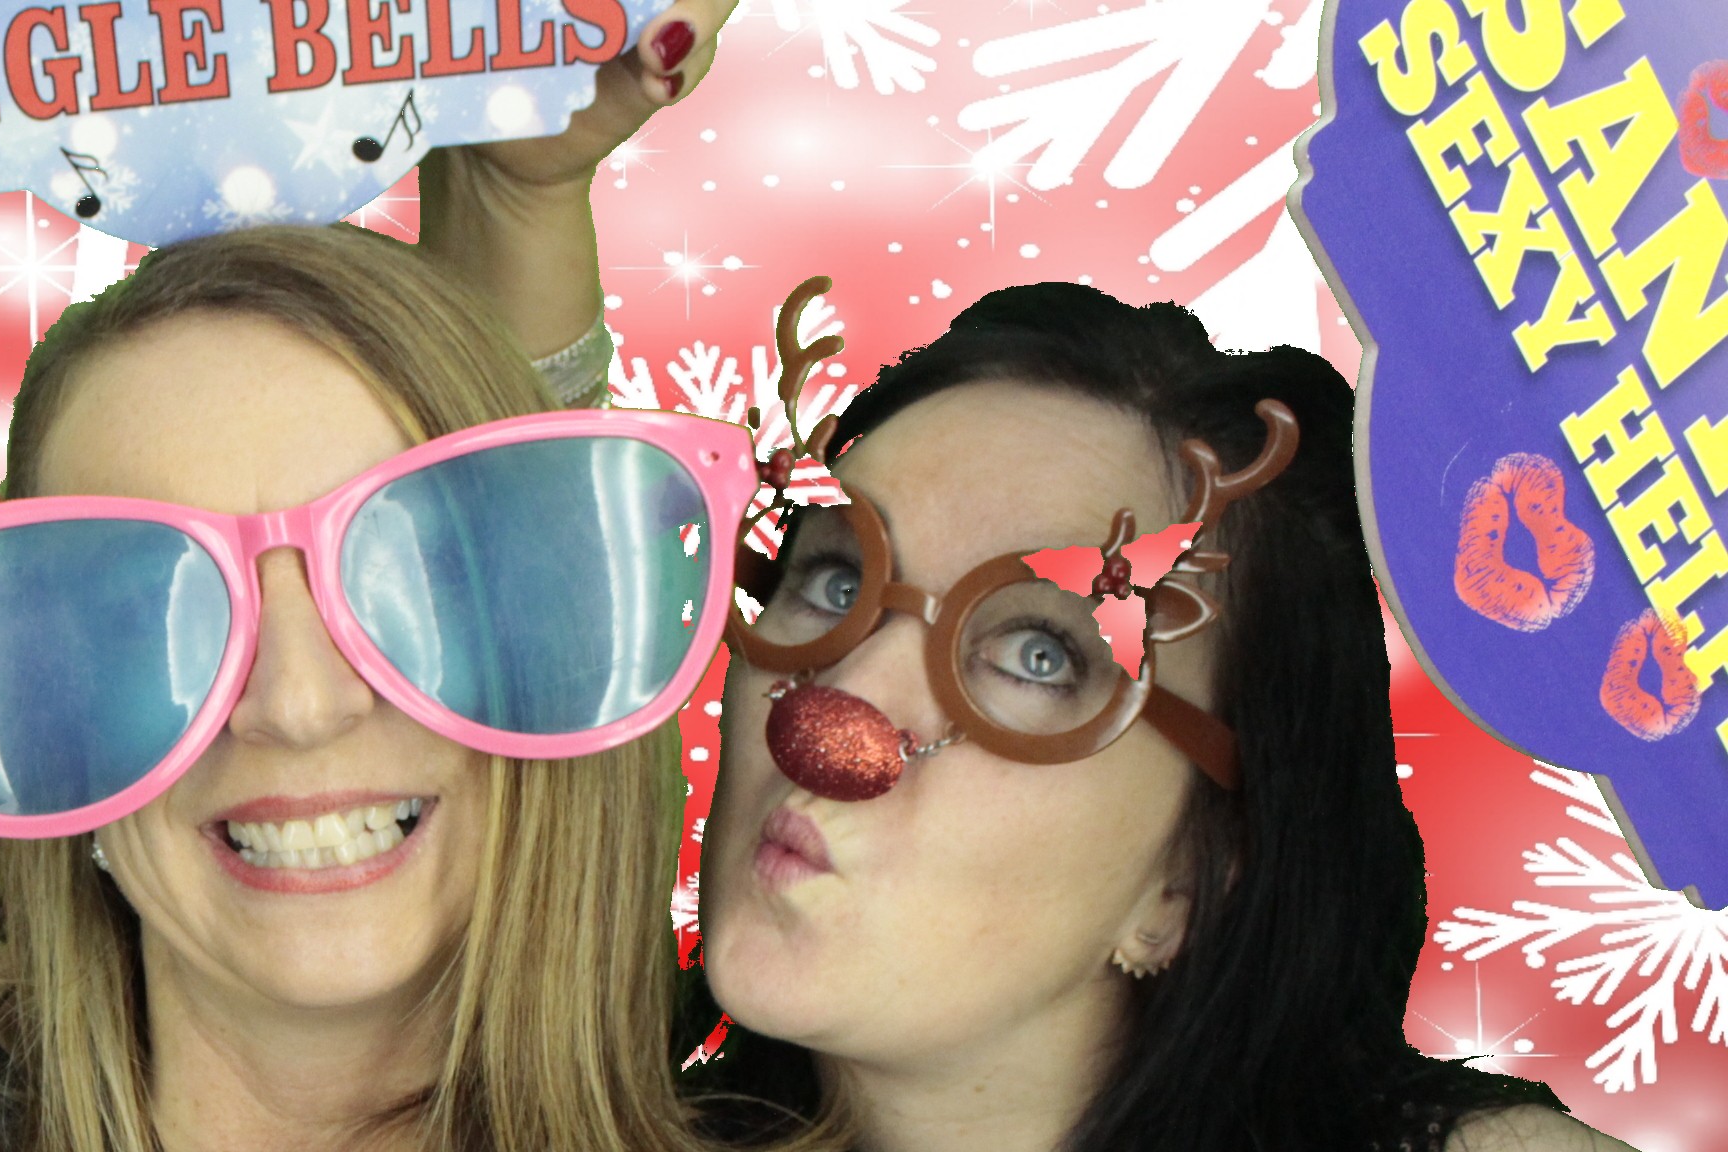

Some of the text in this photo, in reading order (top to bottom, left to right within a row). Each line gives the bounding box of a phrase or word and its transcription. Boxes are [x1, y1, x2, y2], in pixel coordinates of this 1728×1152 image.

[268, 0, 628, 94] BELLS
[1359, 0, 1617, 373] SEXY
[1462, 0, 1728, 498] SAN
